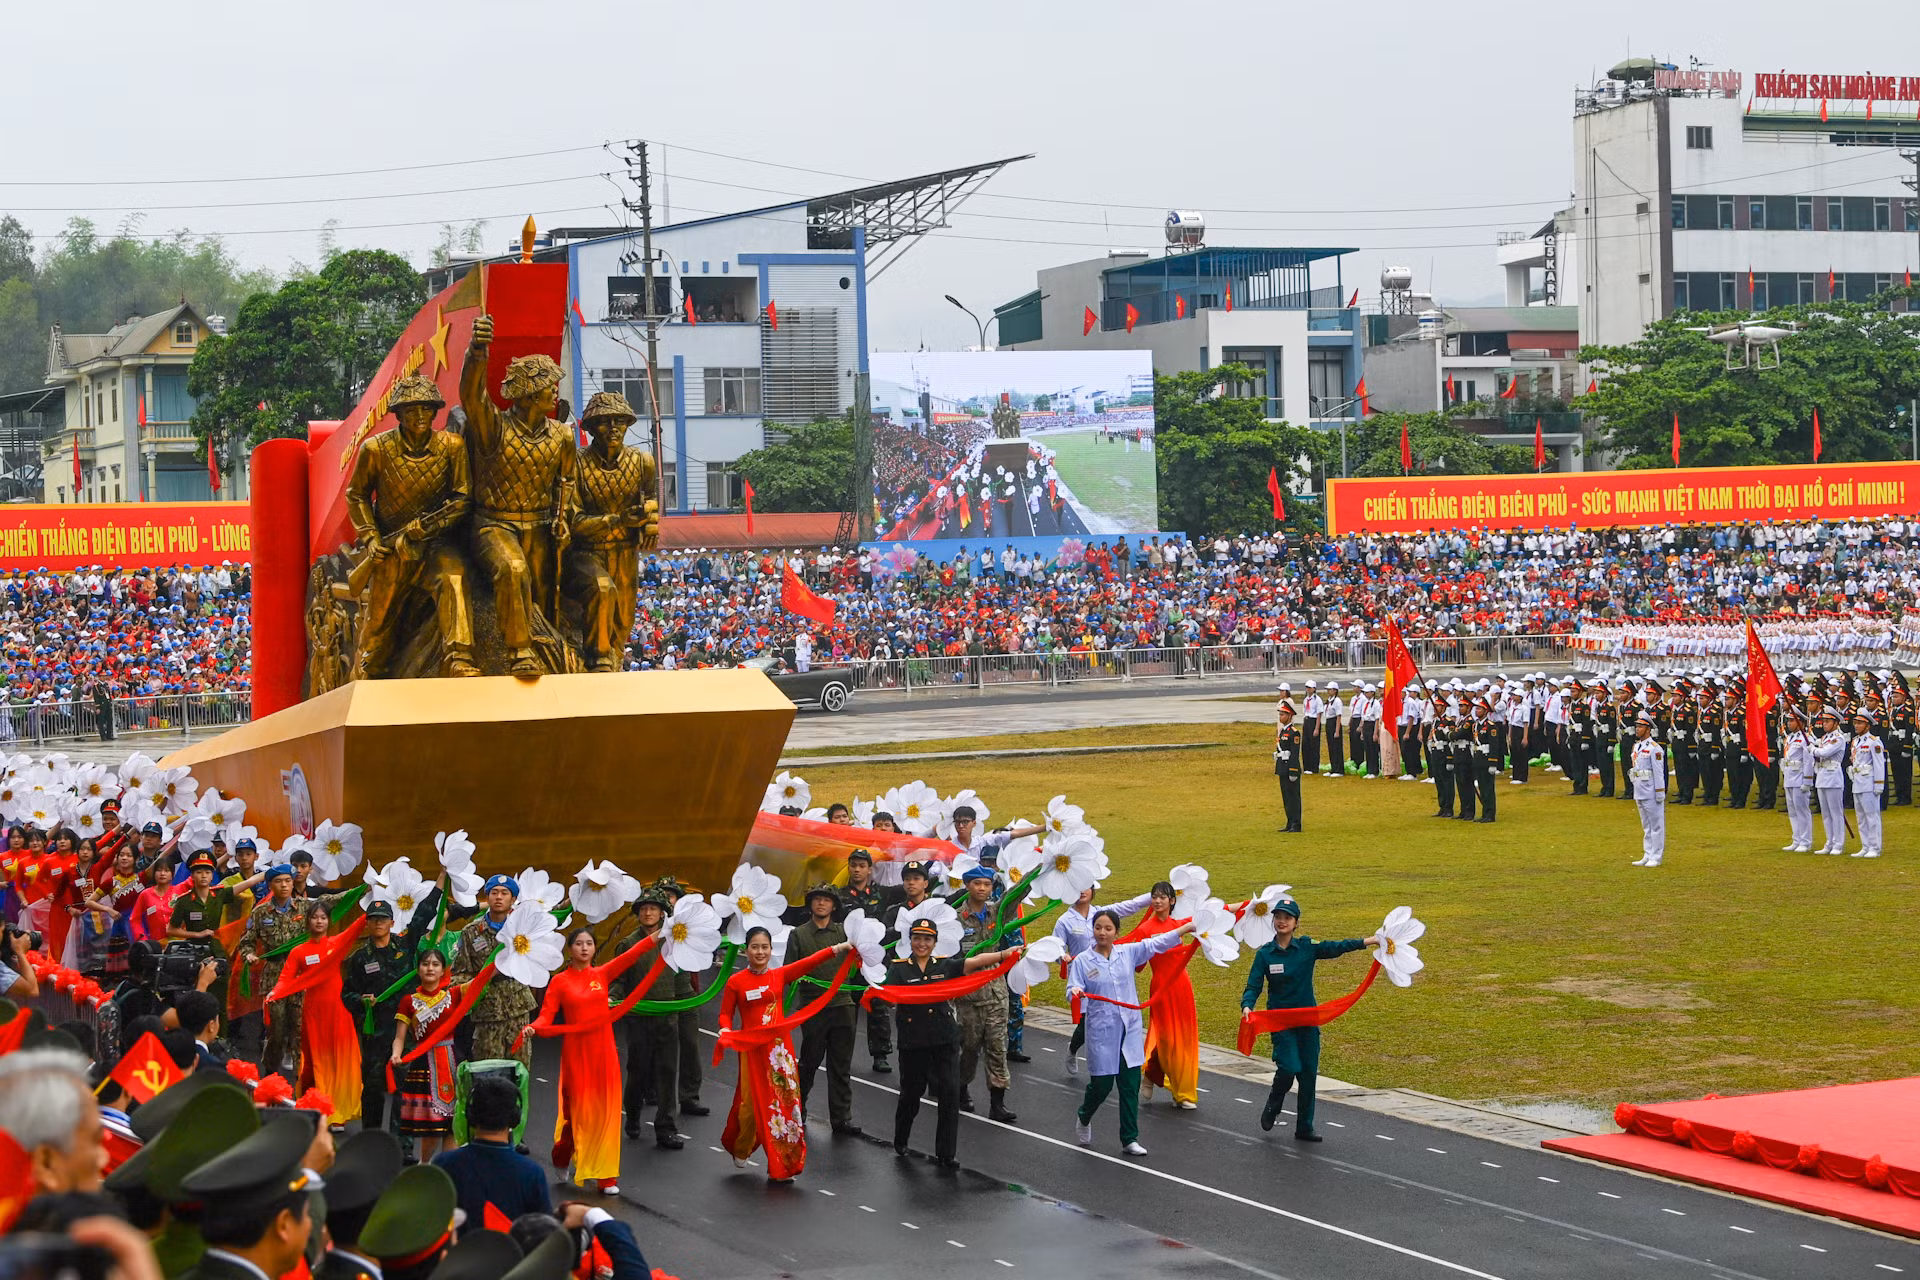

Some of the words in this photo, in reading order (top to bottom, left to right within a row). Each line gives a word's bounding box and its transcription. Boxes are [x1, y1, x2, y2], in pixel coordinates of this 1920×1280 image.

[1755, 69, 1807, 98] KHÁCH
[1845, 71, 1896, 100] HOÀNG
[1363, 490, 1407, 521] CHIẾN
[1410, 488, 1458, 520] THẮNG
[1461, 491, 1496, 523] ĐIỆN
[1500, 490, 1534, 518] BIÊN
[1538, 486, 1568, 517] PHỦ
[1582, 487, 1612, 516] SỨC
[1615, 489, 1660, 519] MẠNH
[1663, 484, 1694, 517] VIỆT
[1698, 487, 1733, 511] NAM
[1737, 480, 1771, 510] THỜI
[1774, 485, 1799, 513] ĐẠI
[1803, 476, 1824, 507] HỒ
[1828, 478, 1853, 506] CHÍ
[41, 518, 89, 556] THẮNG
[92, 521, 127, 561] ĐIỆN
[130, 521, 165, 555] BIÊN
[168, 516, 198, 553] PHỦ
[212, 519, 251, 552] LỪNG
